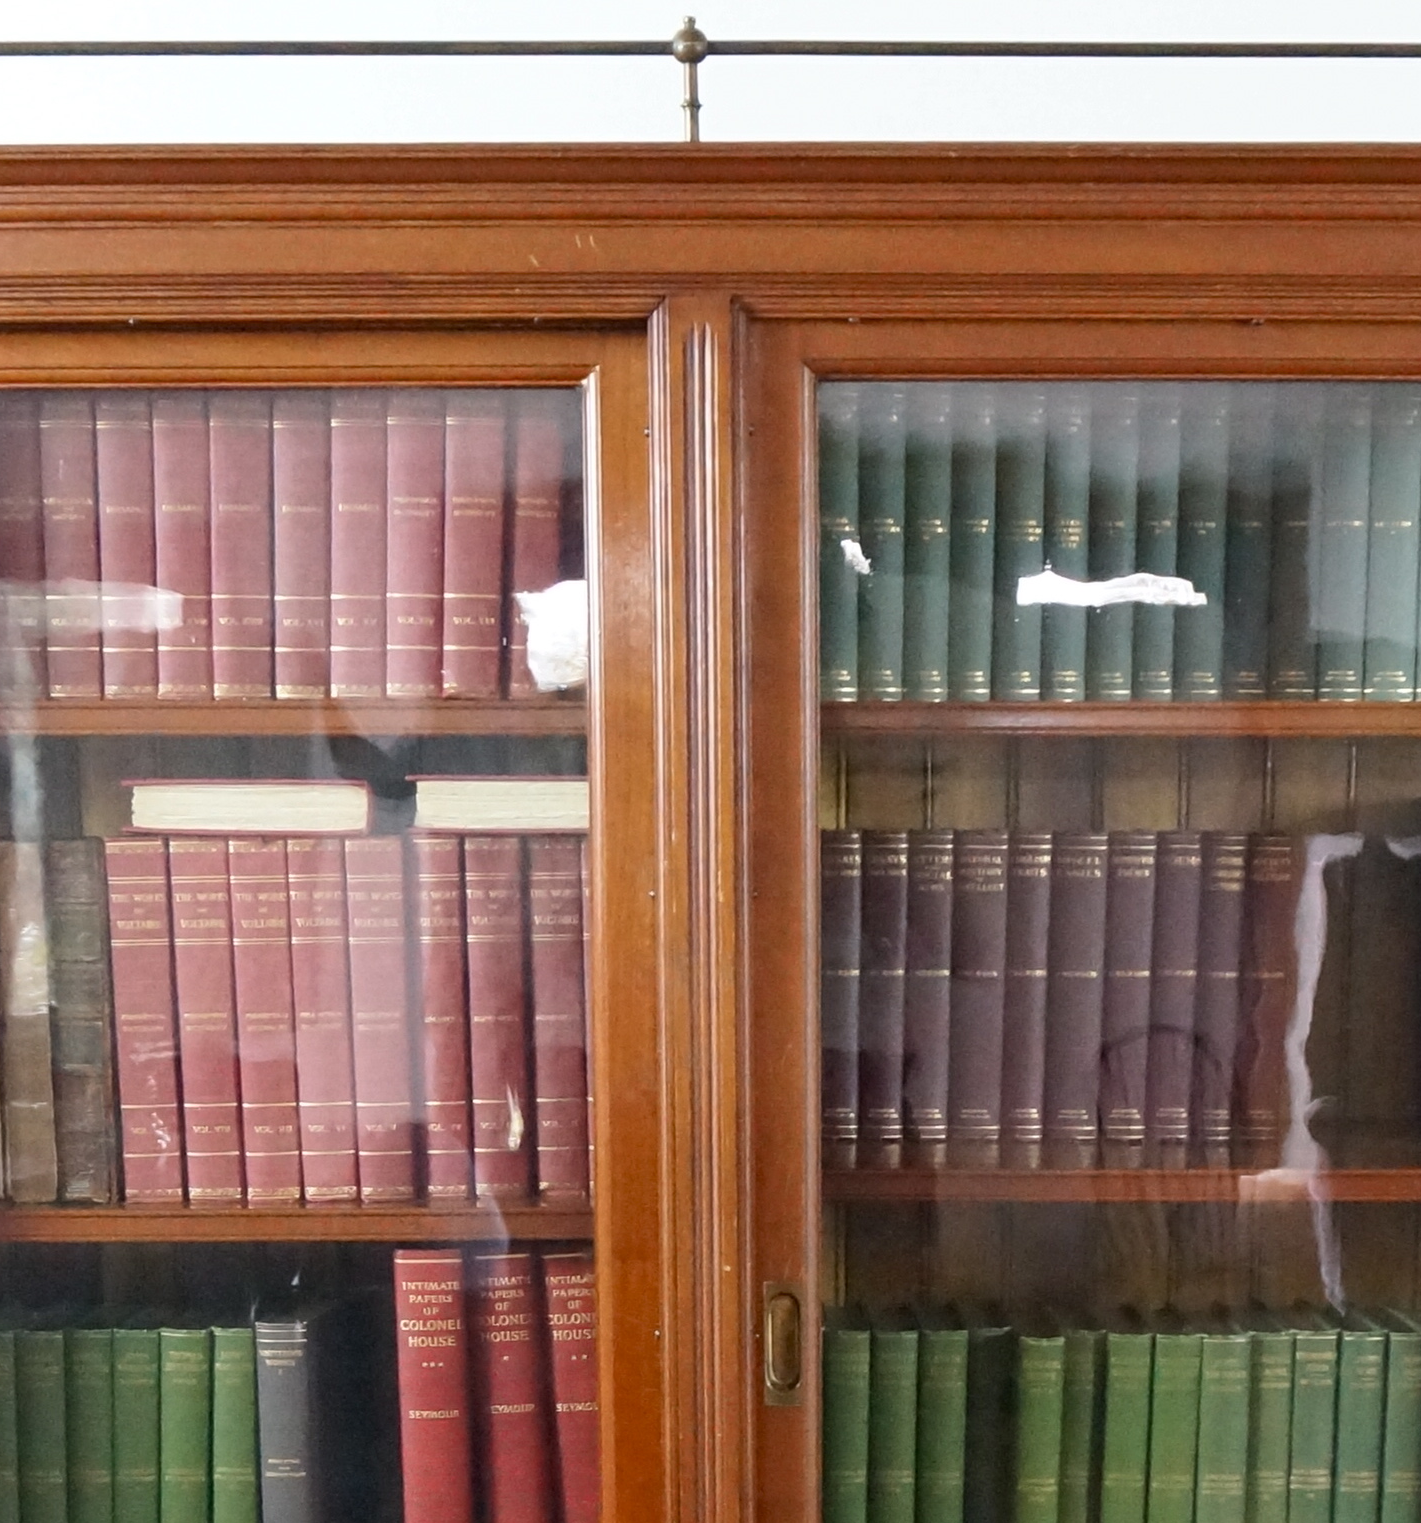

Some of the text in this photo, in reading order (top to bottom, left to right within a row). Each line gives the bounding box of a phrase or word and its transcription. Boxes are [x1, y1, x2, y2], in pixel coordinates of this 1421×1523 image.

[402, 1281, 460, 1291] INTIMATE
[409, 1294, 453, 1304] PAPERS
[494, 1301, 510, 1311] OF
[567, 1300, 582, 1310] OF
[422, 1307, 440, 1316] OF
[400, 1319, 462, 1331] COLONEL
[407, 1335, 457, 1348] HOUSE
[408, 1410, 459, 1419] SEYMOUR
